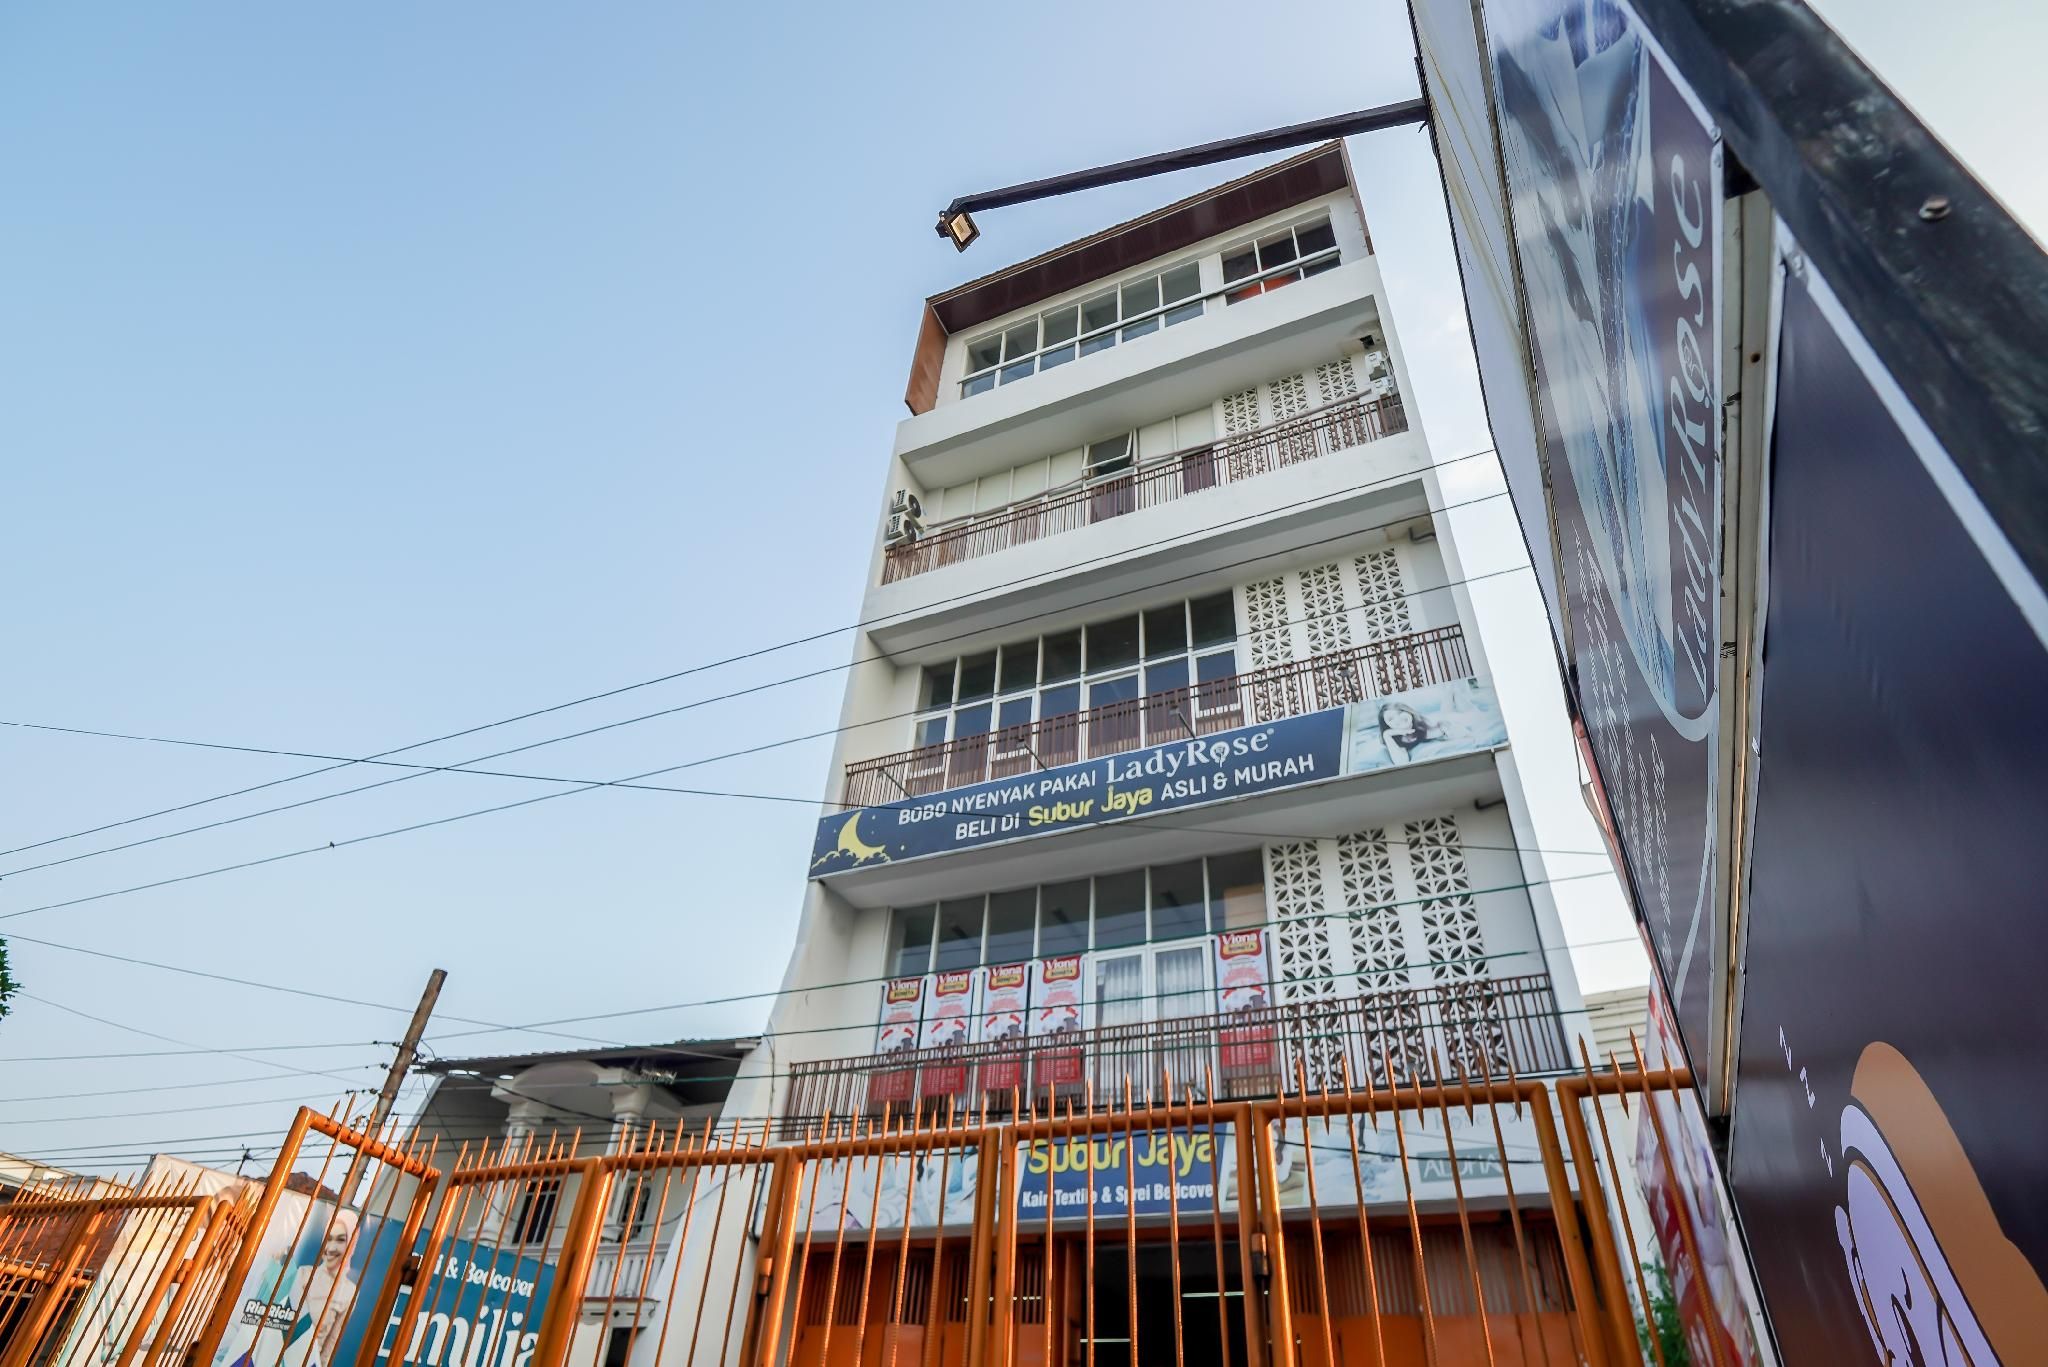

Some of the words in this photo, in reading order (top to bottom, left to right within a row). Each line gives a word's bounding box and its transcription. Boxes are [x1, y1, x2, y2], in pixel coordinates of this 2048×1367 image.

[1586, 548, 1614, 696] JAYA
[899, 802, 947, 825] BOBO
[952, 783, 1035, 813] NYENYAK
[1040, 770, 1096, 796] PAKAI
[1106, 729, 1271, 784] LadyRose
[955, 818, 996, 840] BELI
[1001, 812, 1020, 832] DI
[1028, 799, 1094, 826] Subur
[1101, 785, 1152, 815] Jaya
[1161, 776, 1207, 801] ASLI
[1213, 772, 1227, 791] &
[1234, 753, 1315, 786] MURAH
[1102, 1186, 1111, 1203] &
[1154, 1182, 1215, 1200] Bedcove
[444, 1256, 459, 1279] &
[461, 1260, 536, 1297] Bedcover
